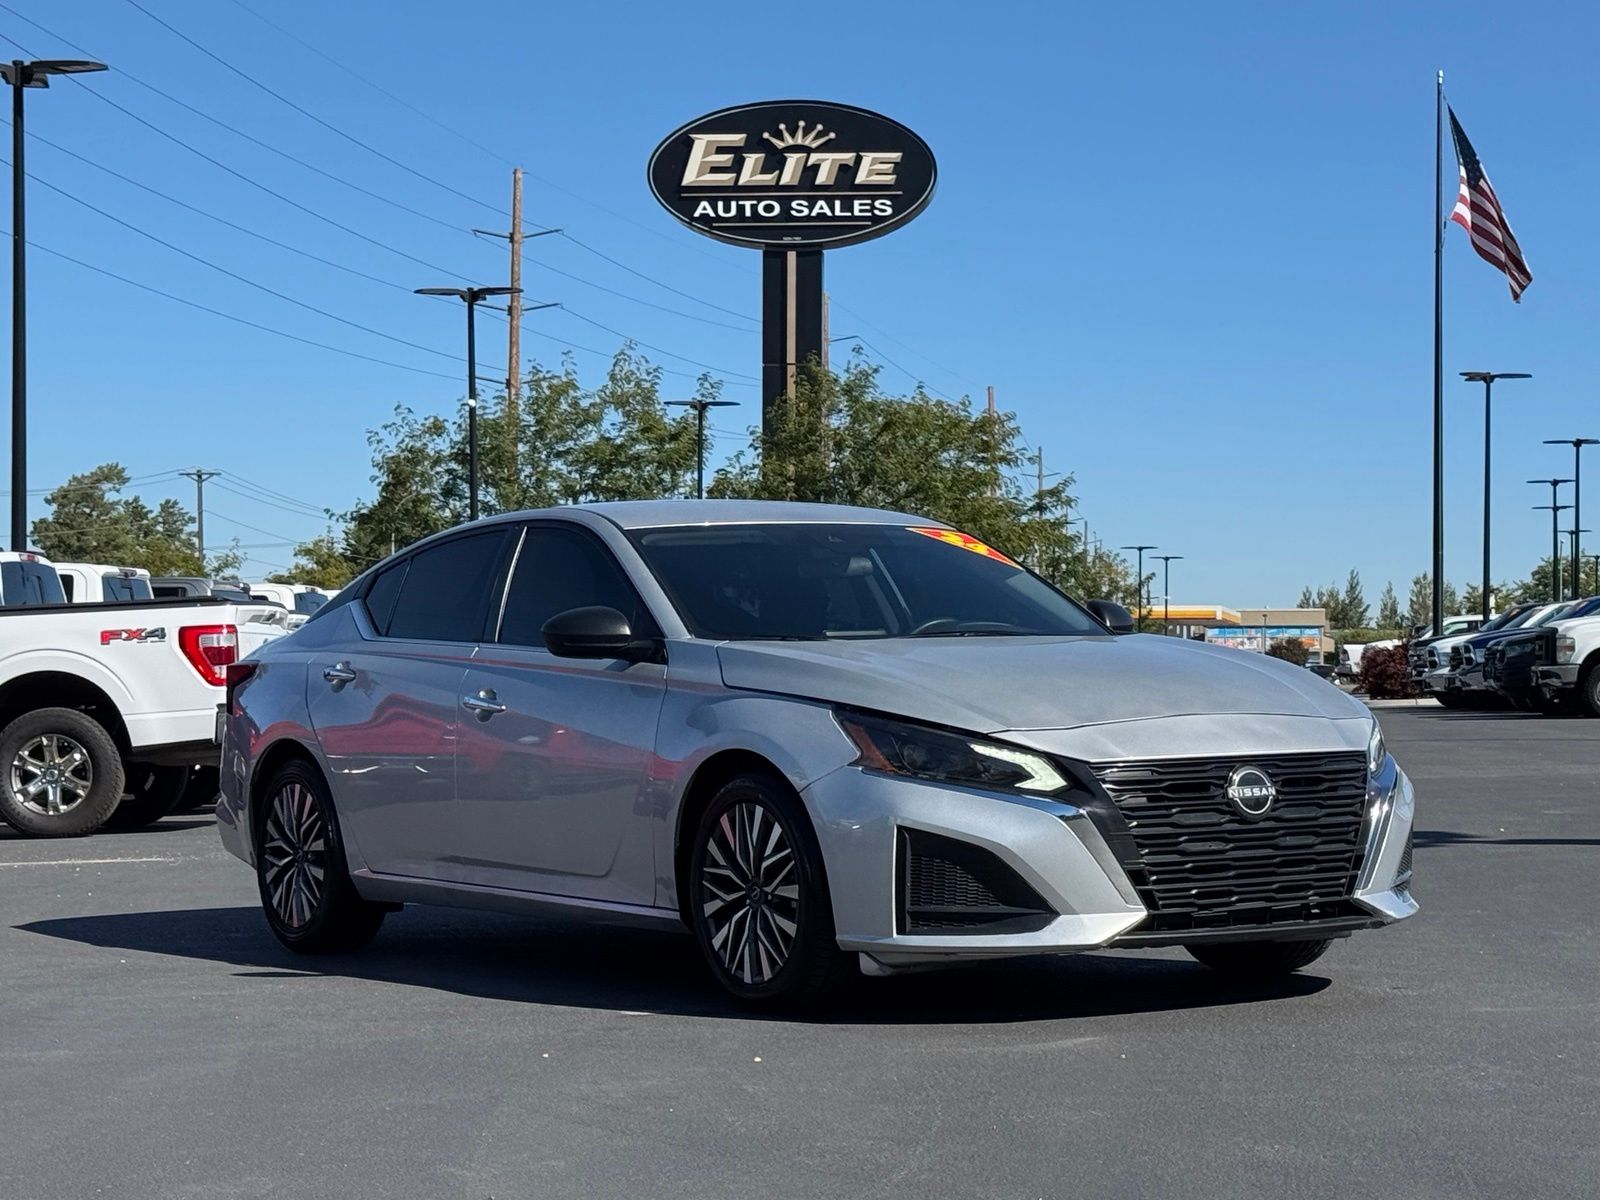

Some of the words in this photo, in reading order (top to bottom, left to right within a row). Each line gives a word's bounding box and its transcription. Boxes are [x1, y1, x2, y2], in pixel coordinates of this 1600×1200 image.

[680, 133, 903, 187] ELITE
[693, 200, 780, 218] AUTO
[790, 199, 893, 217] SALES
[100, 627, 166, 645] FX4
[1229, 787, 1276, 798] NISSAN
